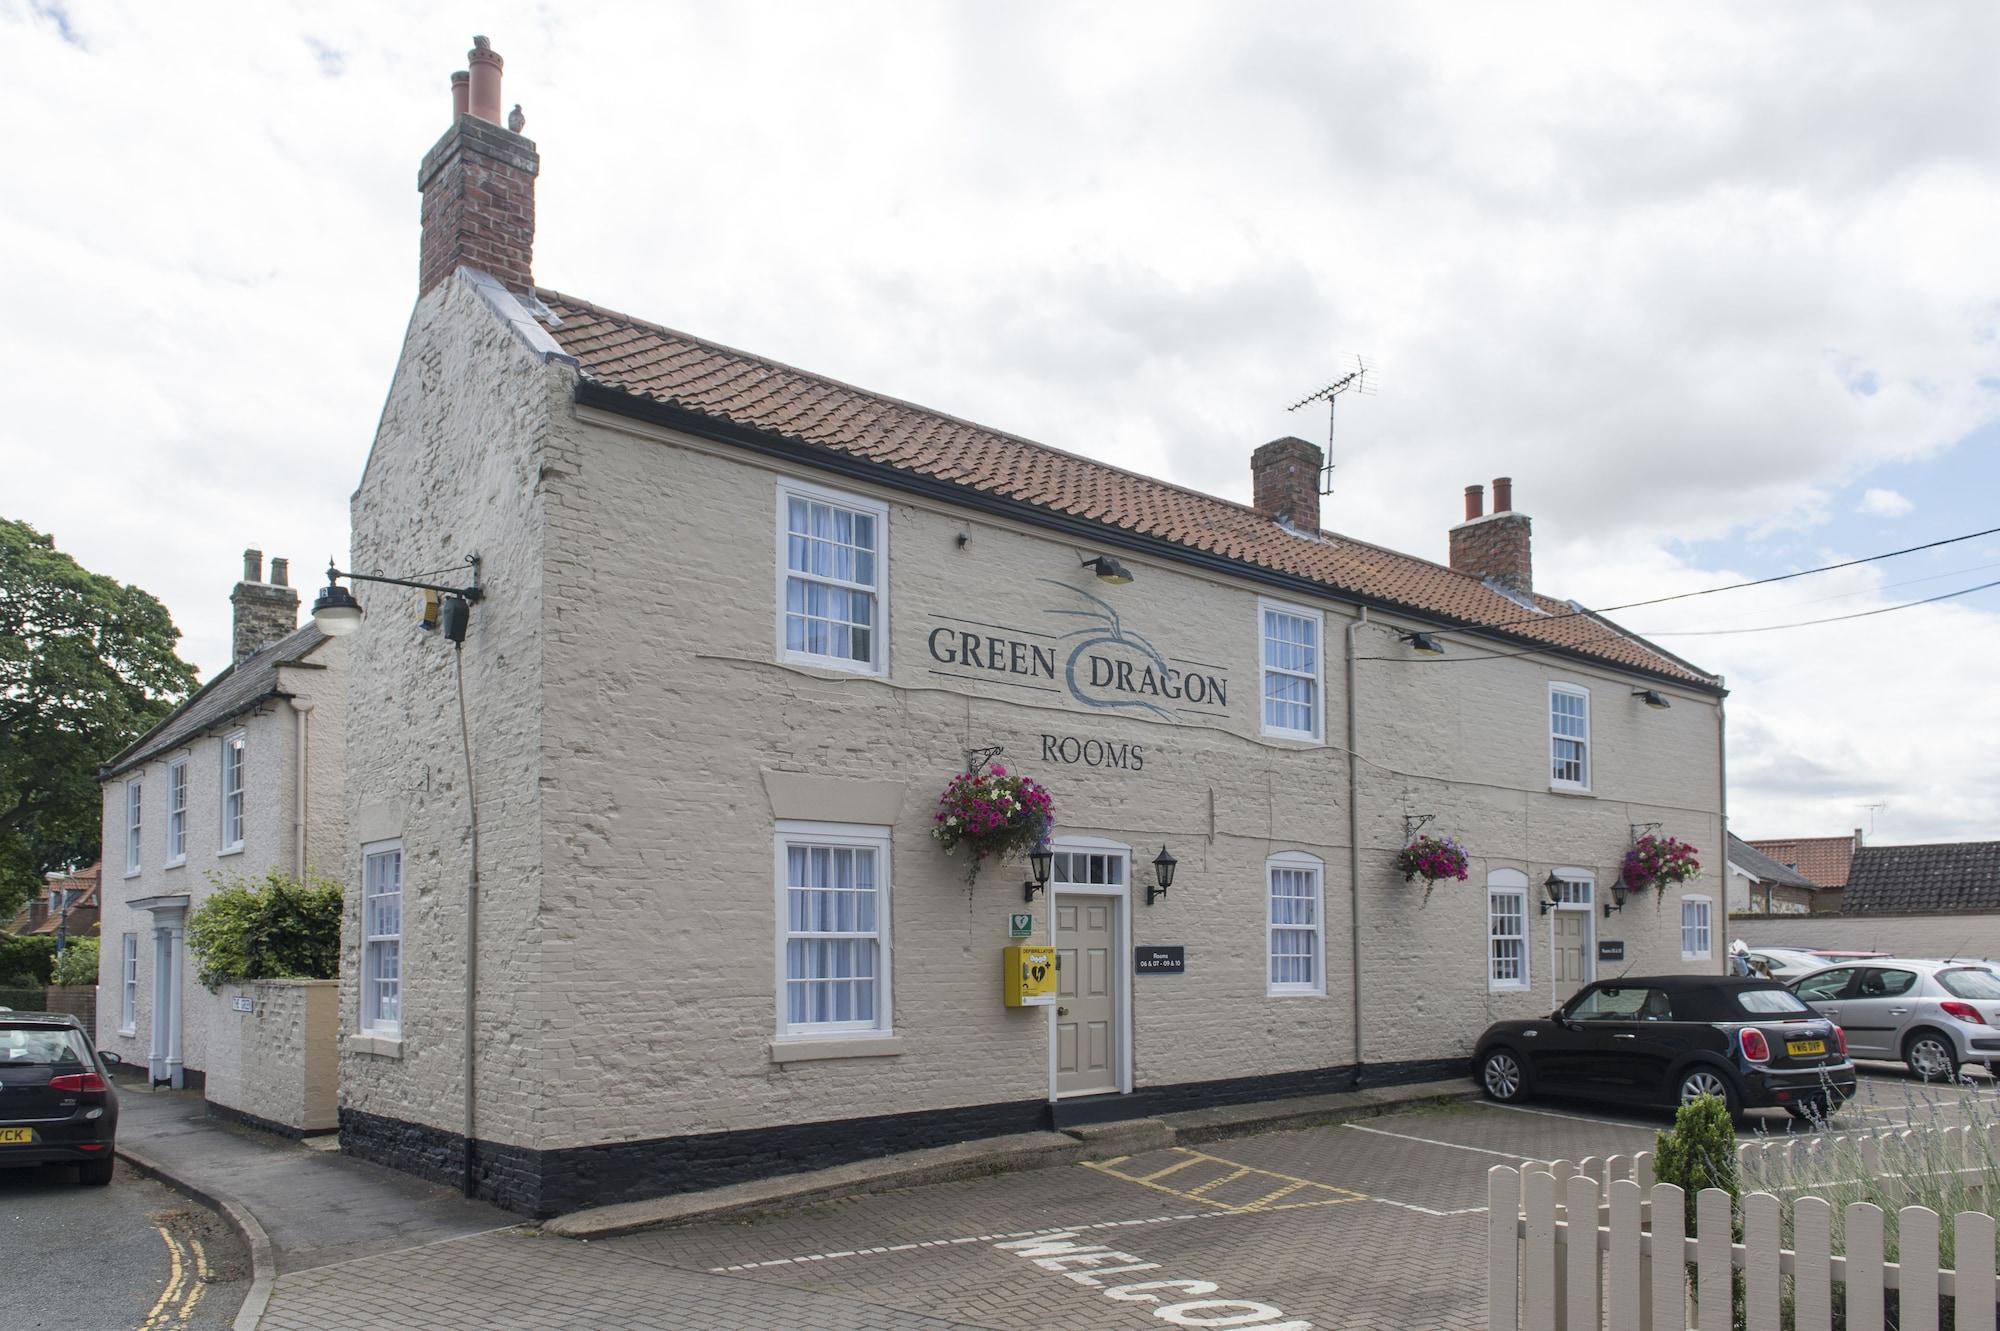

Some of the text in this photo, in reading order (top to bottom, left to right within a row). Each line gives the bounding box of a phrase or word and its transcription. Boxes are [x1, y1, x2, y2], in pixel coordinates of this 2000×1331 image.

[928, 627, 1228, 706] GREEN DRAGON
[1041, 734, 1143, 770] ROOMS
[993, 1232, 1313, 1331] WELCO
